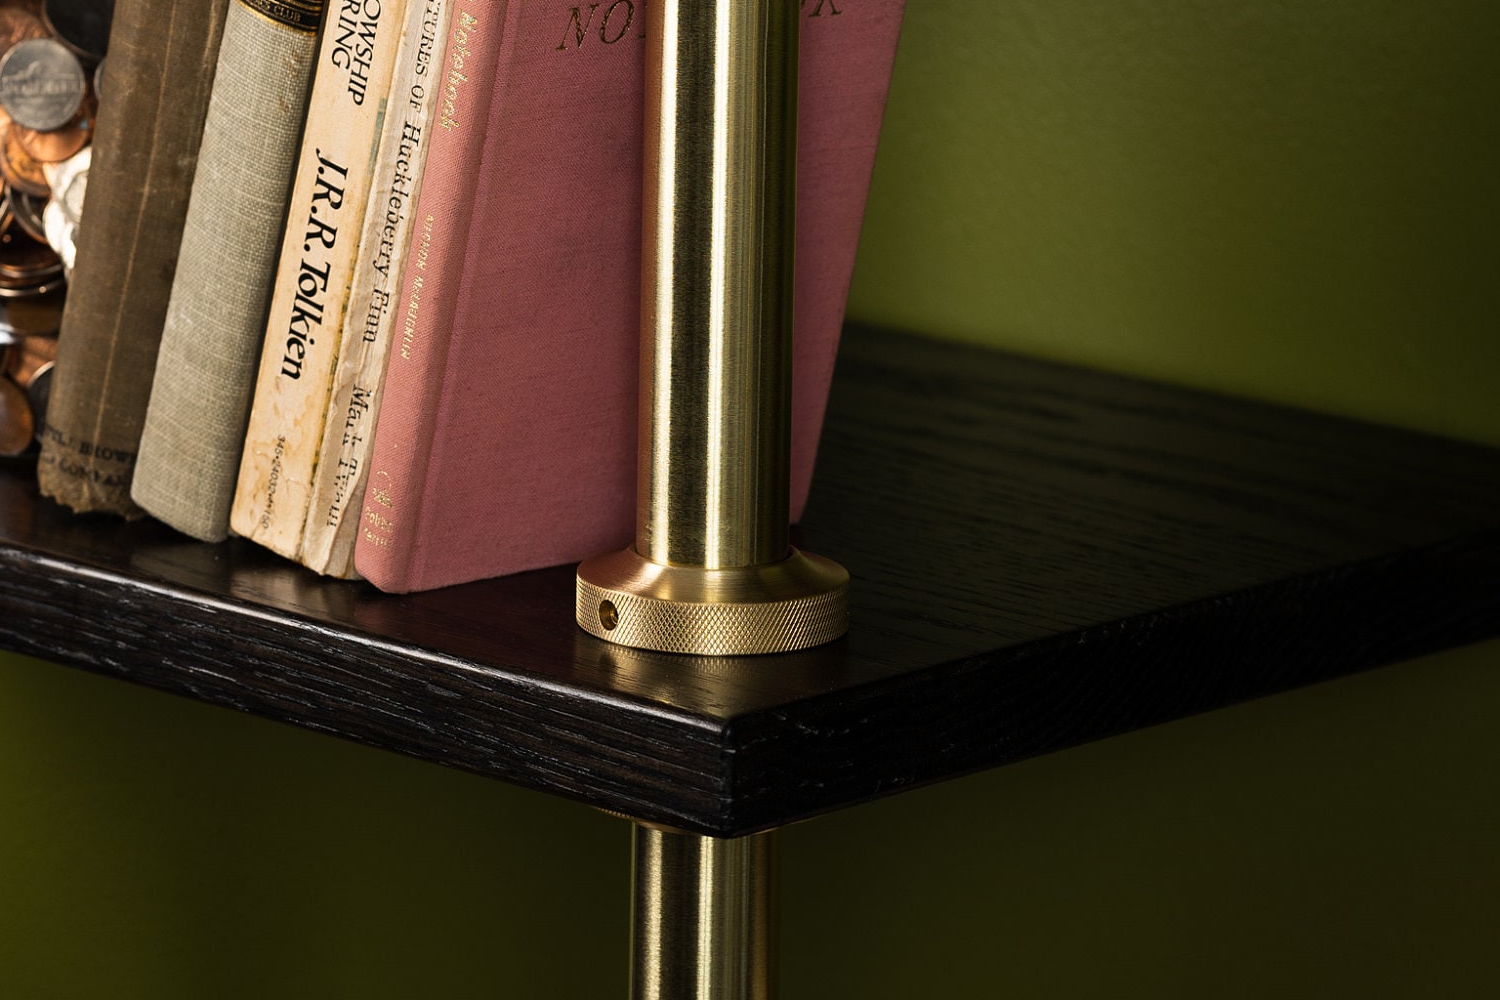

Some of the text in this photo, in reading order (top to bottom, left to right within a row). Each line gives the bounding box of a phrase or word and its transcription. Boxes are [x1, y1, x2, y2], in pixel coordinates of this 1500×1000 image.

[274, 4, 301, 23] CLUB
[410, 84, 425, 114] OF
[439, 8, 478, 132] Notebook
[373, 120, 421, 278] Huckleberry
[280, 148, 348, 380] J.R.R. Tolkien
[363, 288, 390, 343] Finn
